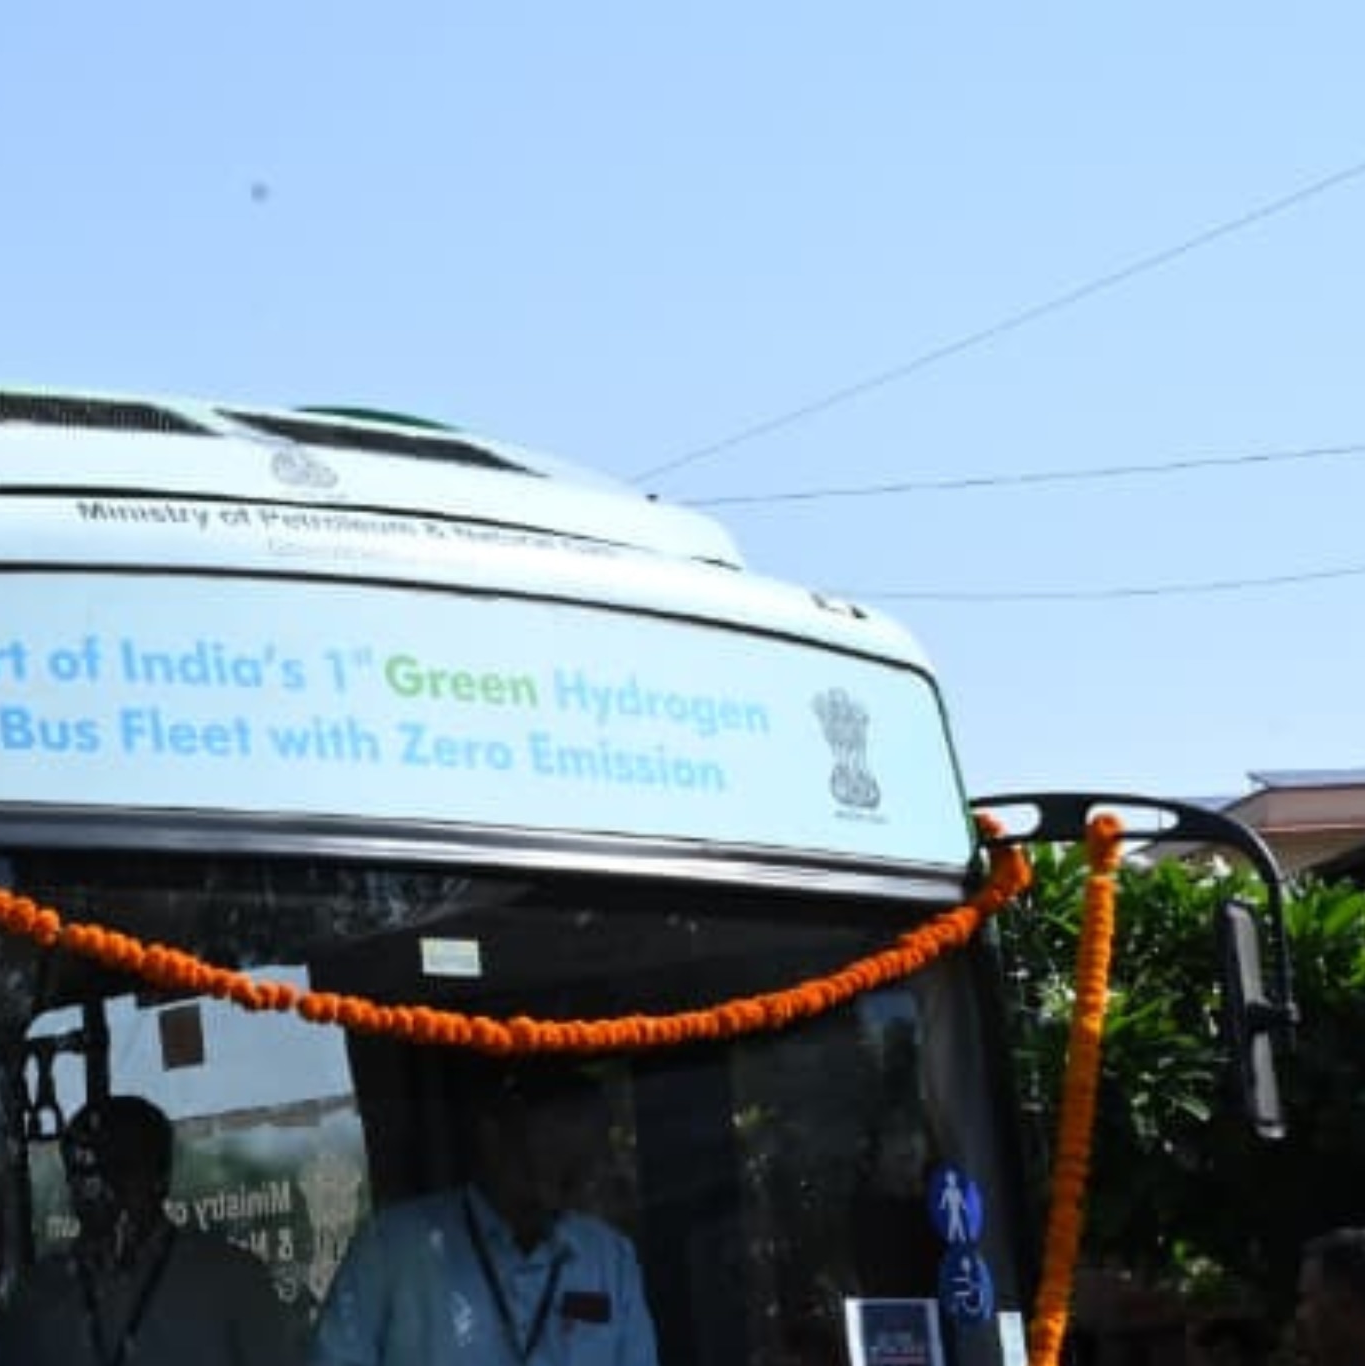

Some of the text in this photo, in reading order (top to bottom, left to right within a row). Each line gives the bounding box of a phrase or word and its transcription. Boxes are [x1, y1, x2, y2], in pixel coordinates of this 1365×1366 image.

[76, 501, 208, 530] Ministry
[220, 507, 251, 527] of
[47, 637, 100, 683] of
[122, 639, 307, 690] India's
[384, 655, 539, 710] Green
[553, 668, 771, 738] Hydrogen
[120, 708, 254, 757] Fleet
[268, 717, 381, 764] with
[396, 723, 514, 772] Zero
[529, 731, 727, 792] Emission
